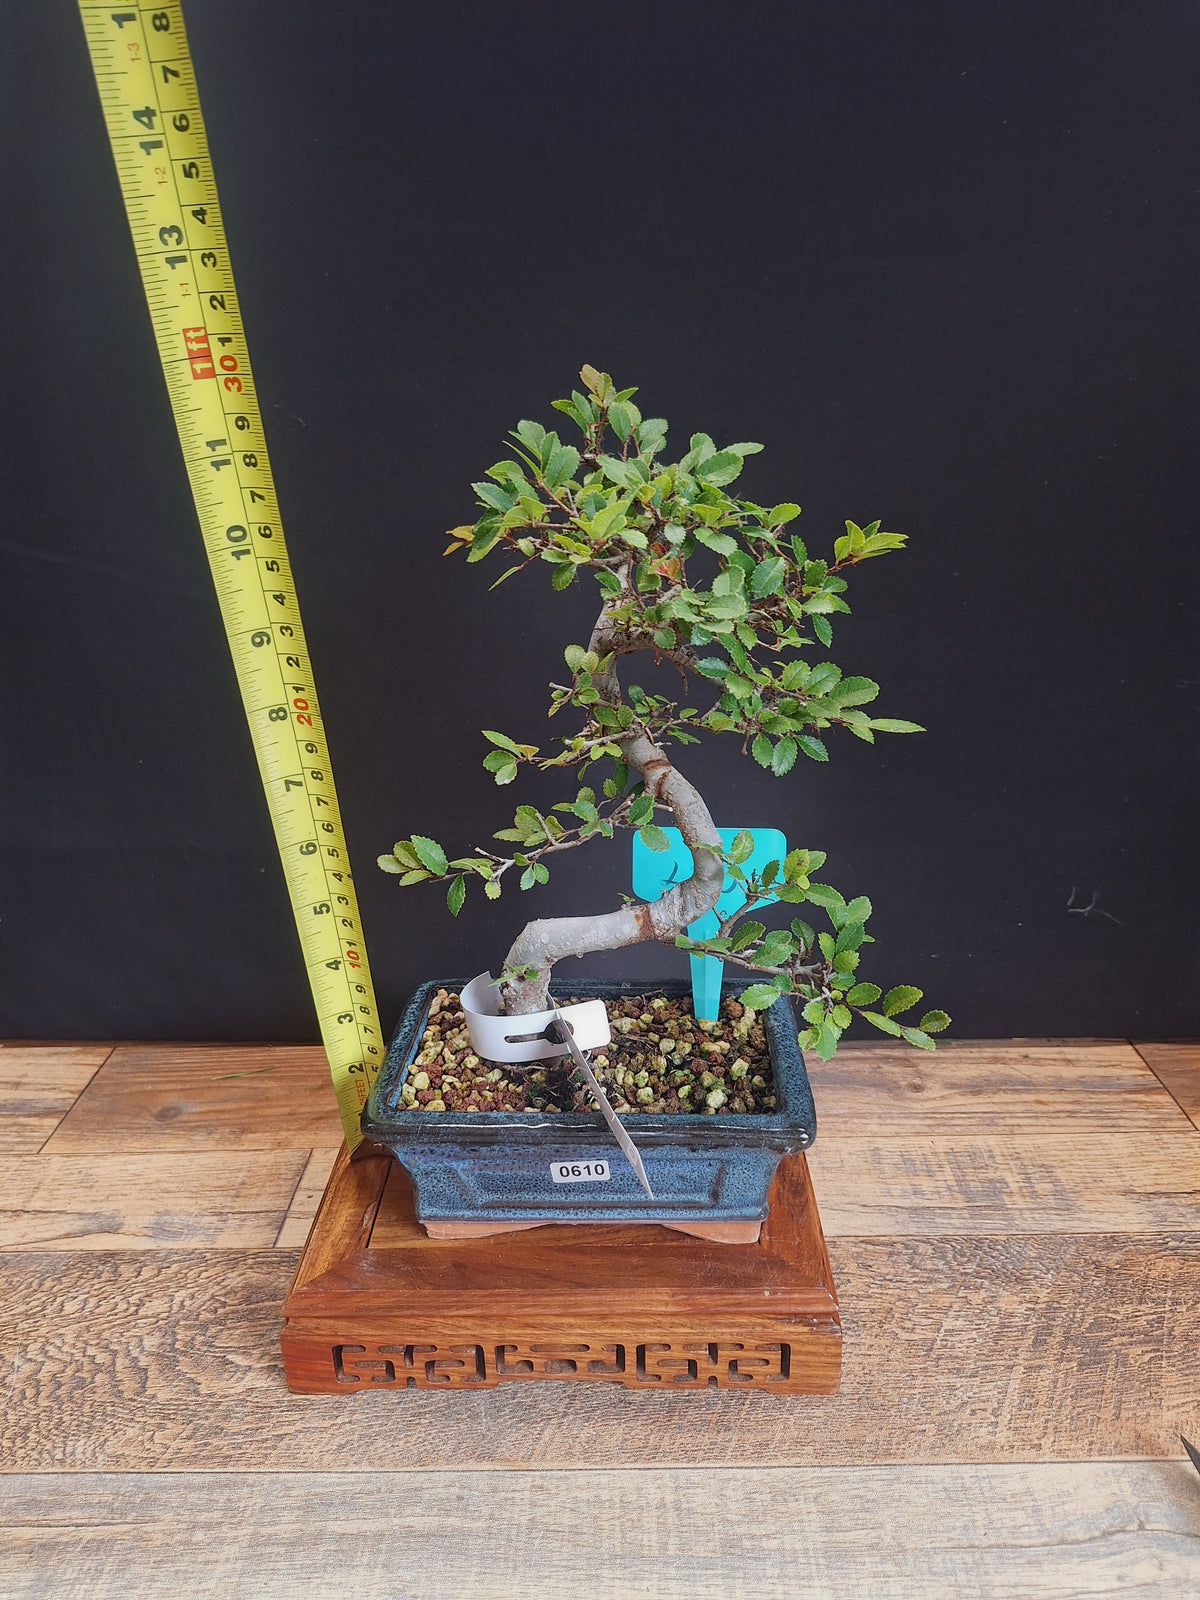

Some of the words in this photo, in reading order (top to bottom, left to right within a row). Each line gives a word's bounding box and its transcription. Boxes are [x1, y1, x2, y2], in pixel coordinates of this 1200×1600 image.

[152, 11, 170, 32] 8
[127, 43, 141, 62] 1-3
[162, 65, 180, 83] 7
[173, 113, 189, 132] 6
[132, 106, 163, 155] 14
[155, 167, 168, 186] 1-2
[182, 161, 199, 179] 5
[192, 207, 207, 224] 4
[159, 225, 188, 270] 13
[201, 252, 217, 268] 3
[179, 283, 191, 298] 1-1
[210, 295, 227, 311] 2
[218, 337, 232, 347] 1
[220, 355, 242, 393] 30
[235, 416, 250, 430] 9
[206, 439, 231, 471] 11
[243, 453, 258, 468] 8
[250, 490, 265, 503] 7
[259, 525, 272, 538] 6
[226, 525, 250, 560] 10
[266, 560, 279, 572] 5
[273, 593, 286, 606] 4
[280, 625, 293, 637] 3
[251, 631, 271, 648] 9
[287, 656, 300, 668] 2
[293, 686, 305, 694] 1
[269, 707, 288, 722] 8
[293, 698, 312, 726] 20
[305, 743, 318, 754] 9
[311, 770, 324, 781] 8
[285, 779, 303, 792] 7
[316, 797, 329, 807] 7
[322, 822, 334, 833] 6
[300, 842, 317, 855] 6
[328, 848, 339, 858] 5
[332, 872, 344, 882] 4
[337, 896, 349, 905] 3
[313, 903, 330, 915] 5
[342, 919, 354, 929] 2
[326, 959, 341, 970] 4
[346, 950, 361, 968] 10
[355, 984, 367, 994] 9
[360, 1005, 370, 1015] 8
[338, 1013, 354, 1024] 3
[364, 1026, 374, 1034] 7
[368, 1045, 378, 1055] 6
[348, 1063, 364, 1073] 2
[560, 1164, 604, 1178] 0610
